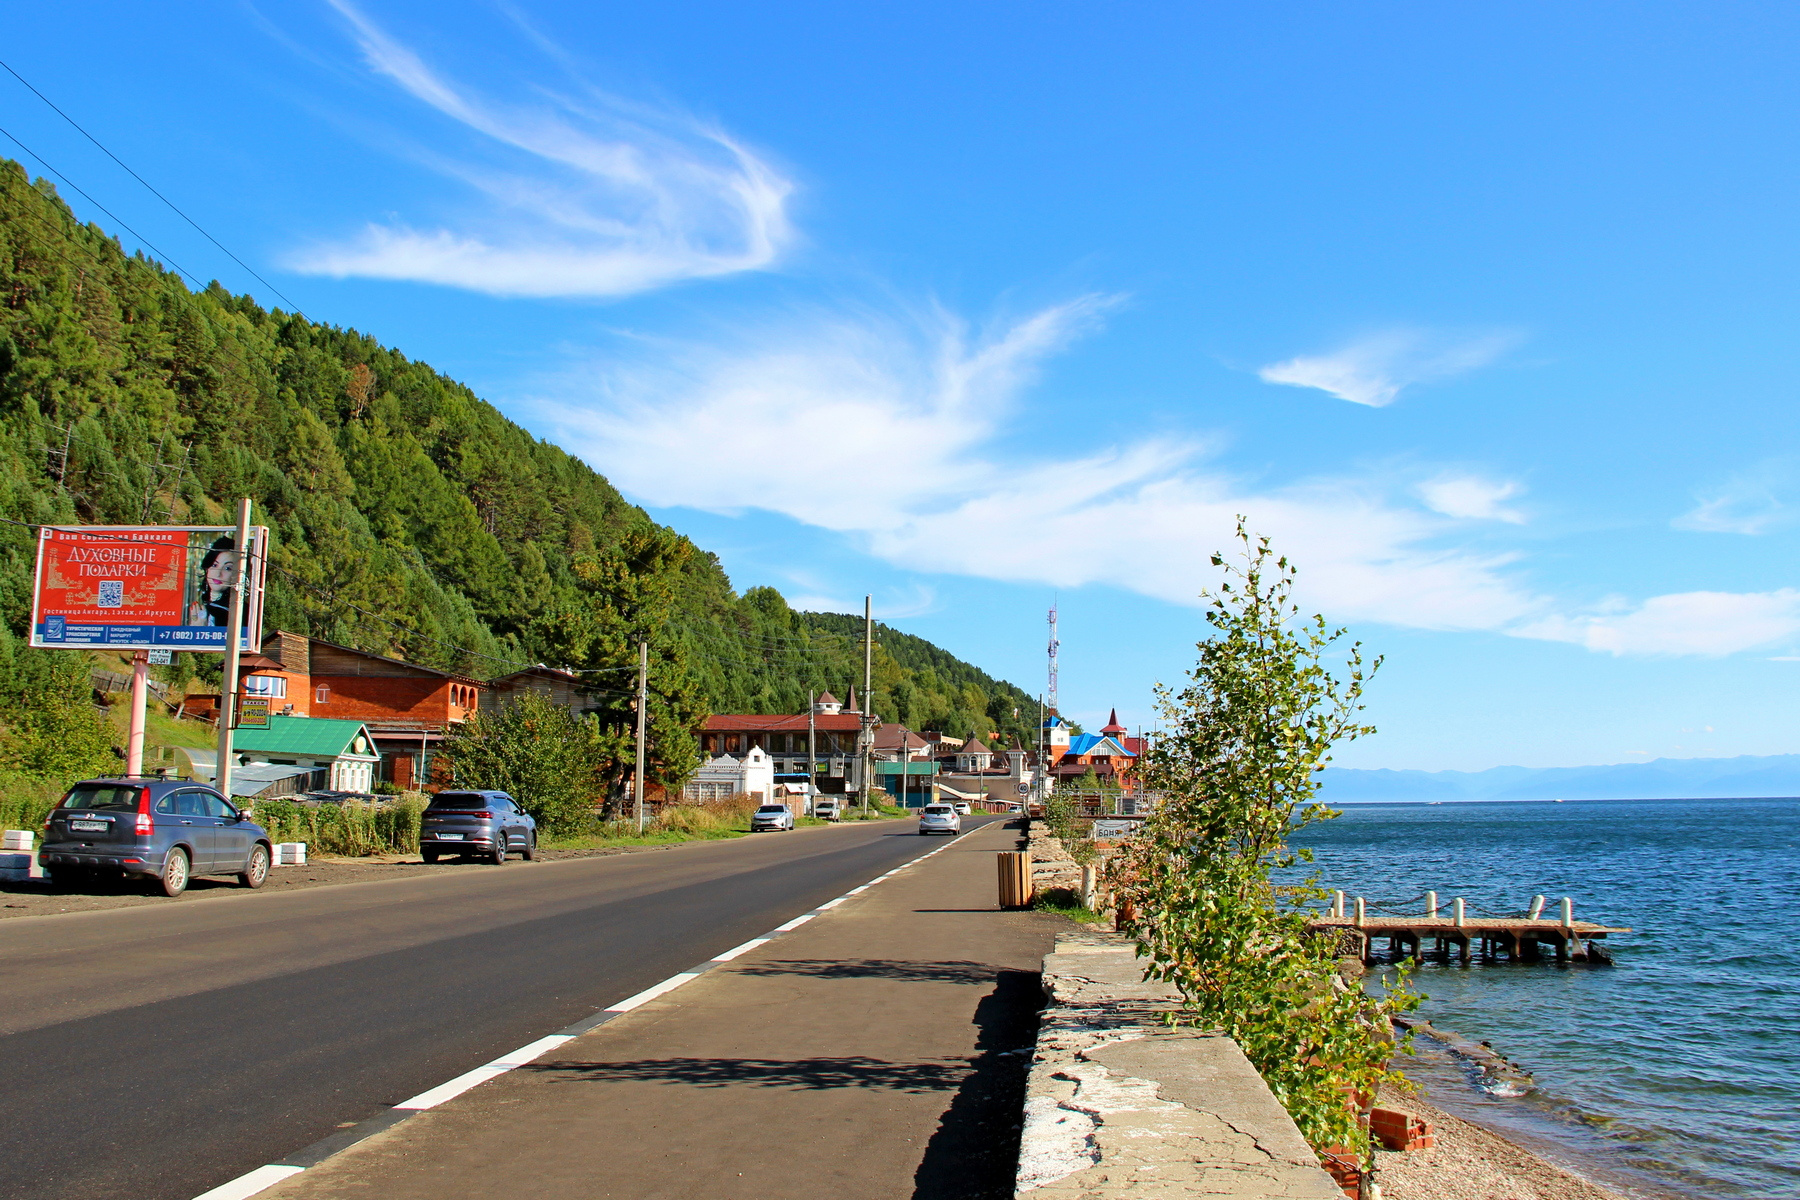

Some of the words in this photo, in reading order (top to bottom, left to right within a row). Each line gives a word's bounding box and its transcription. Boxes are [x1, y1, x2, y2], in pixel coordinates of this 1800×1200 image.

[132, 532, 173, 541] Байкале
[67, 546, 156, 562] ДУХОВНЫЕ
[80, 564, 147, 577] ПОДАРКИ
[83, 609, 110, 617] Ангара,
[159, 631, 171, 639] +7
[172, 631, 193, 640] (902)
[1098, 829, 1119, 837] БАНЯ
